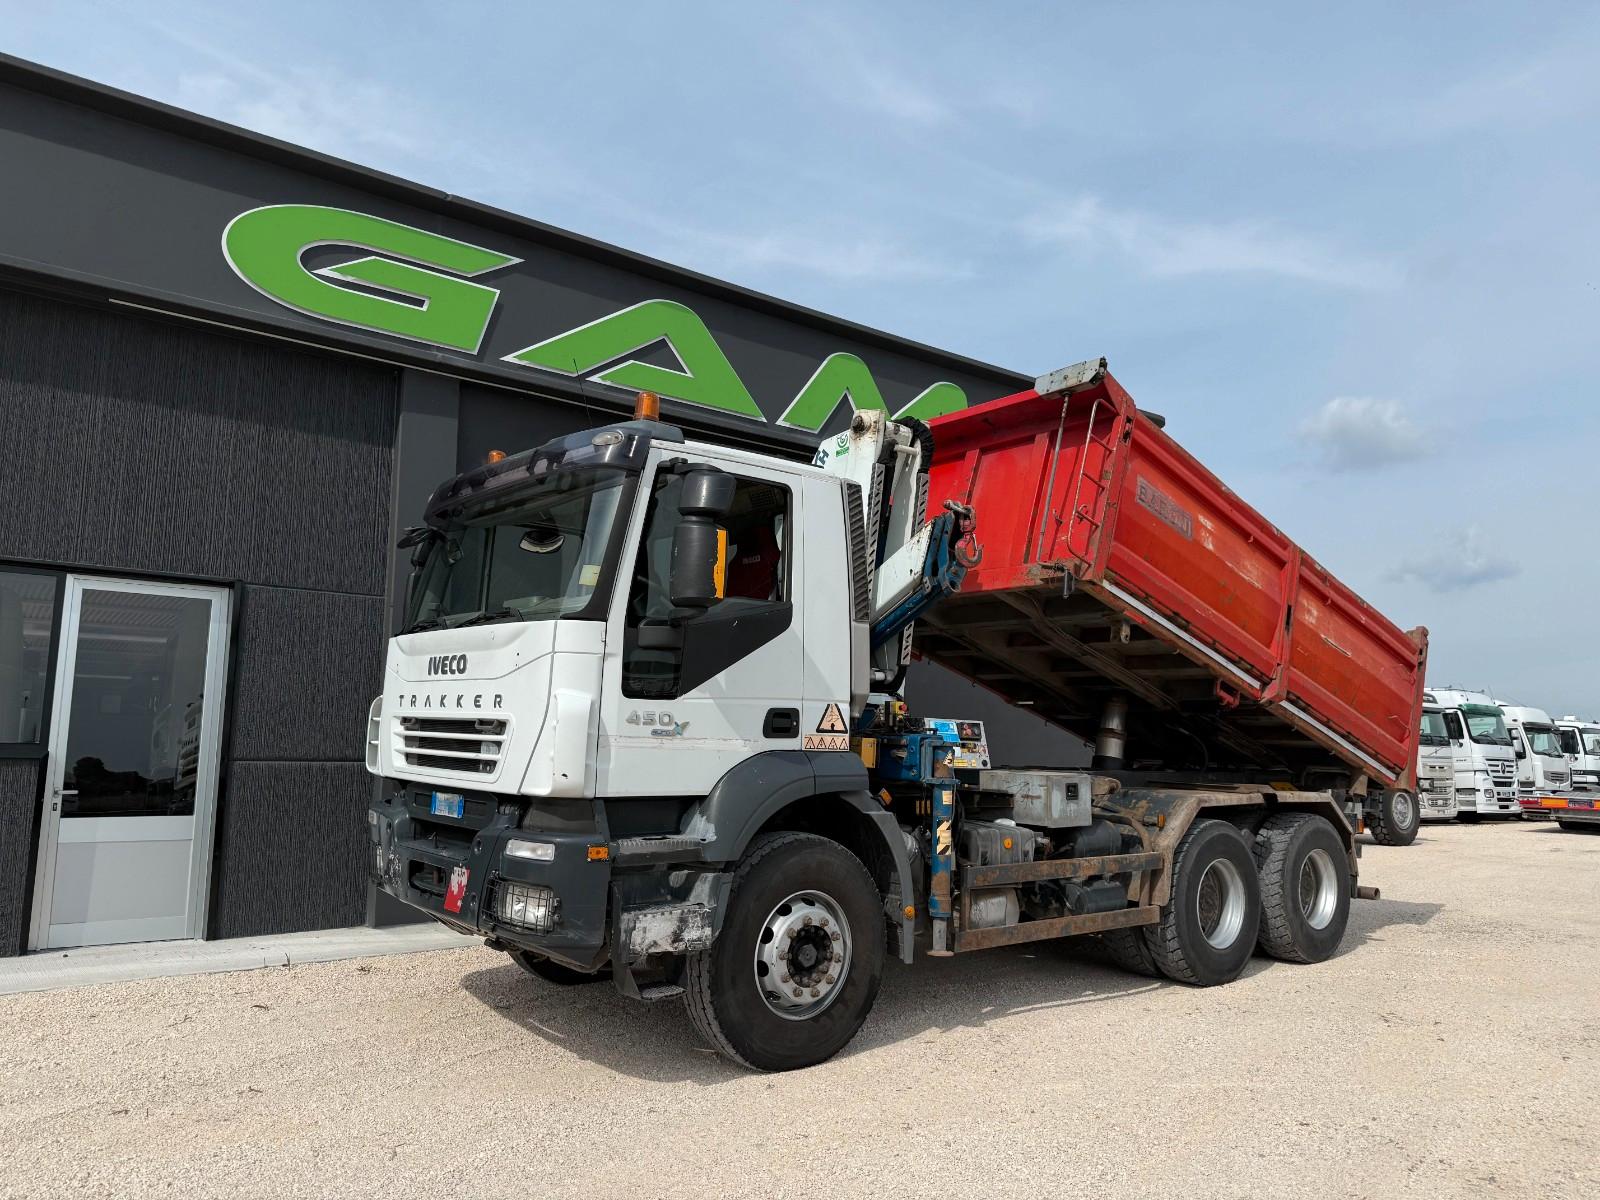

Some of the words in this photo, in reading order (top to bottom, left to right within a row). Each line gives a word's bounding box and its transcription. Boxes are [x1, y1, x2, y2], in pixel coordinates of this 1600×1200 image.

[427, 653, 468, 676] IVECO
[399, 694, 503, 708] TRAKKER
[625, 709, 675, 727] 450
